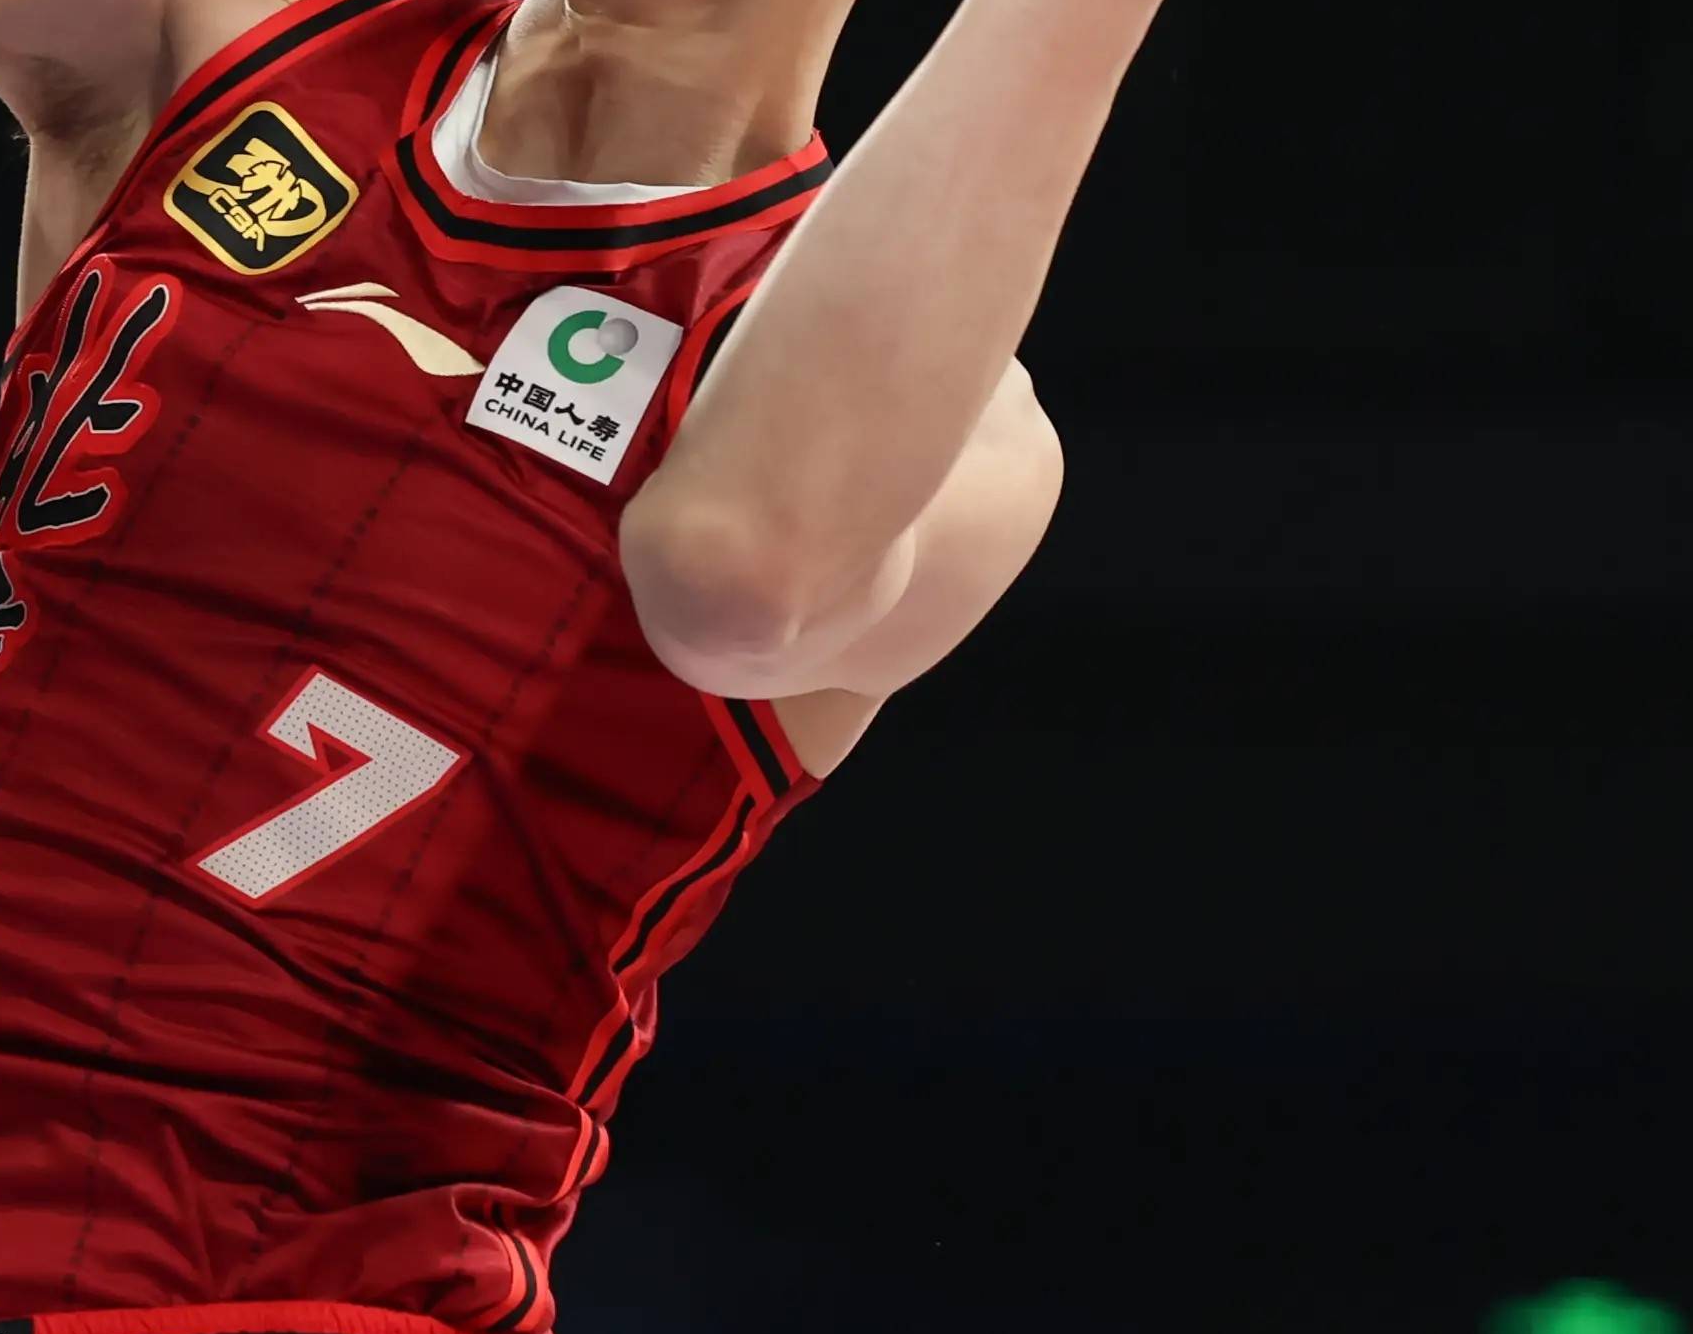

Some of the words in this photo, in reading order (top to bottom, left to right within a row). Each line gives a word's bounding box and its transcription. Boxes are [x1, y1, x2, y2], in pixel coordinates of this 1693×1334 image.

[208, 188, 265, 252] CBA
[485, 398, 550, 436] CHINA
[557, 430, 606, 462] LIFE
[494, 372, 621, 443] 中国人寿
[197, 672, 460, 899] 7
